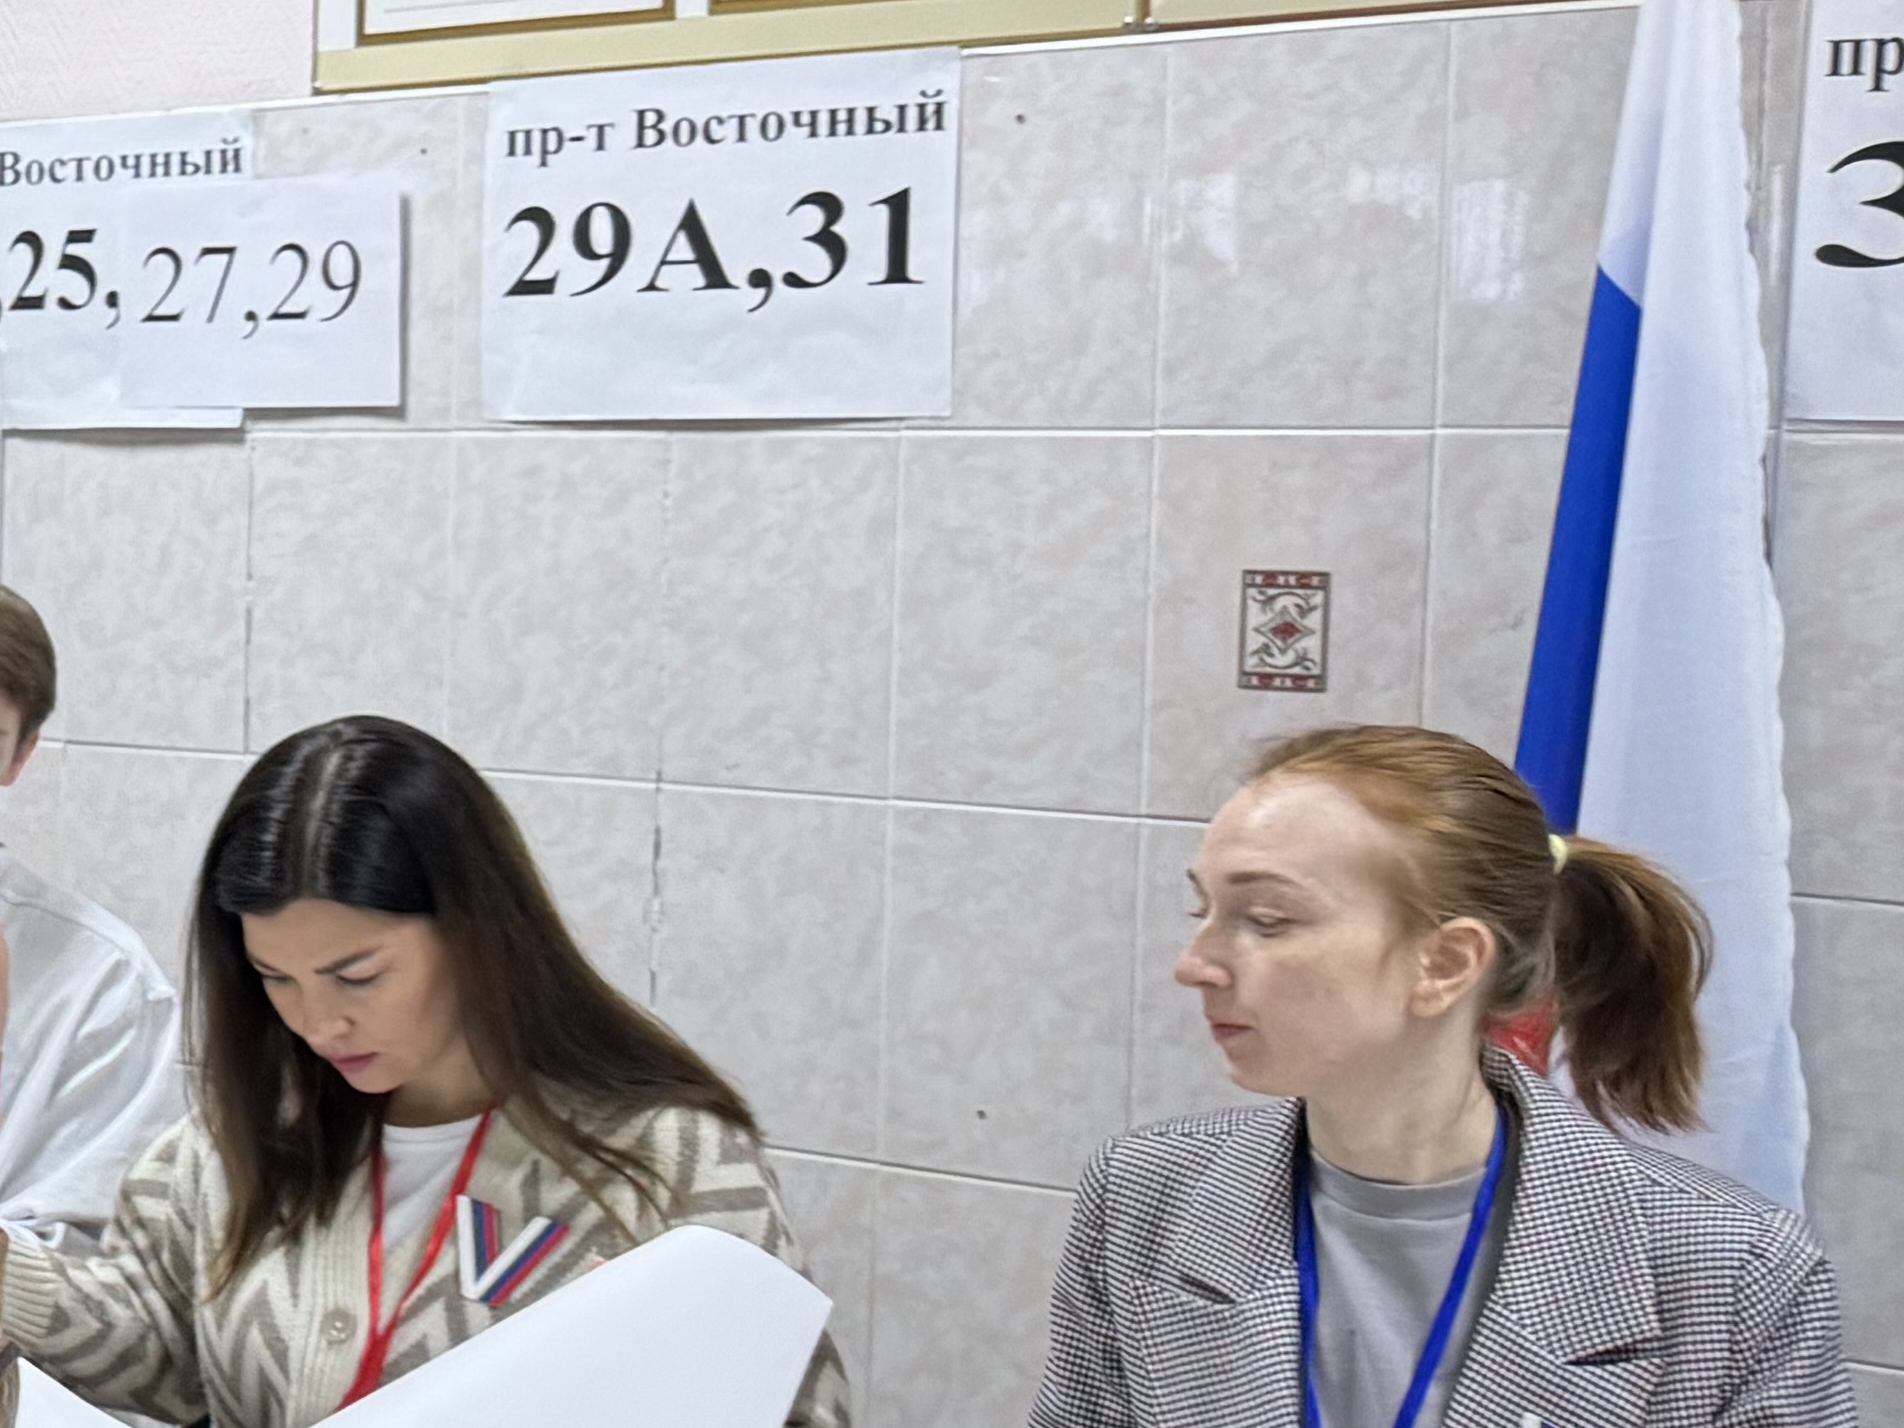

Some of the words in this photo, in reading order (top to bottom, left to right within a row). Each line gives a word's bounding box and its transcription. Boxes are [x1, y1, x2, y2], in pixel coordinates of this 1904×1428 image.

[504, 121, 616, 169] пр-т
[631, 88, 949, 152] Восточный
[502, 184, 926, 314] 29А,31
